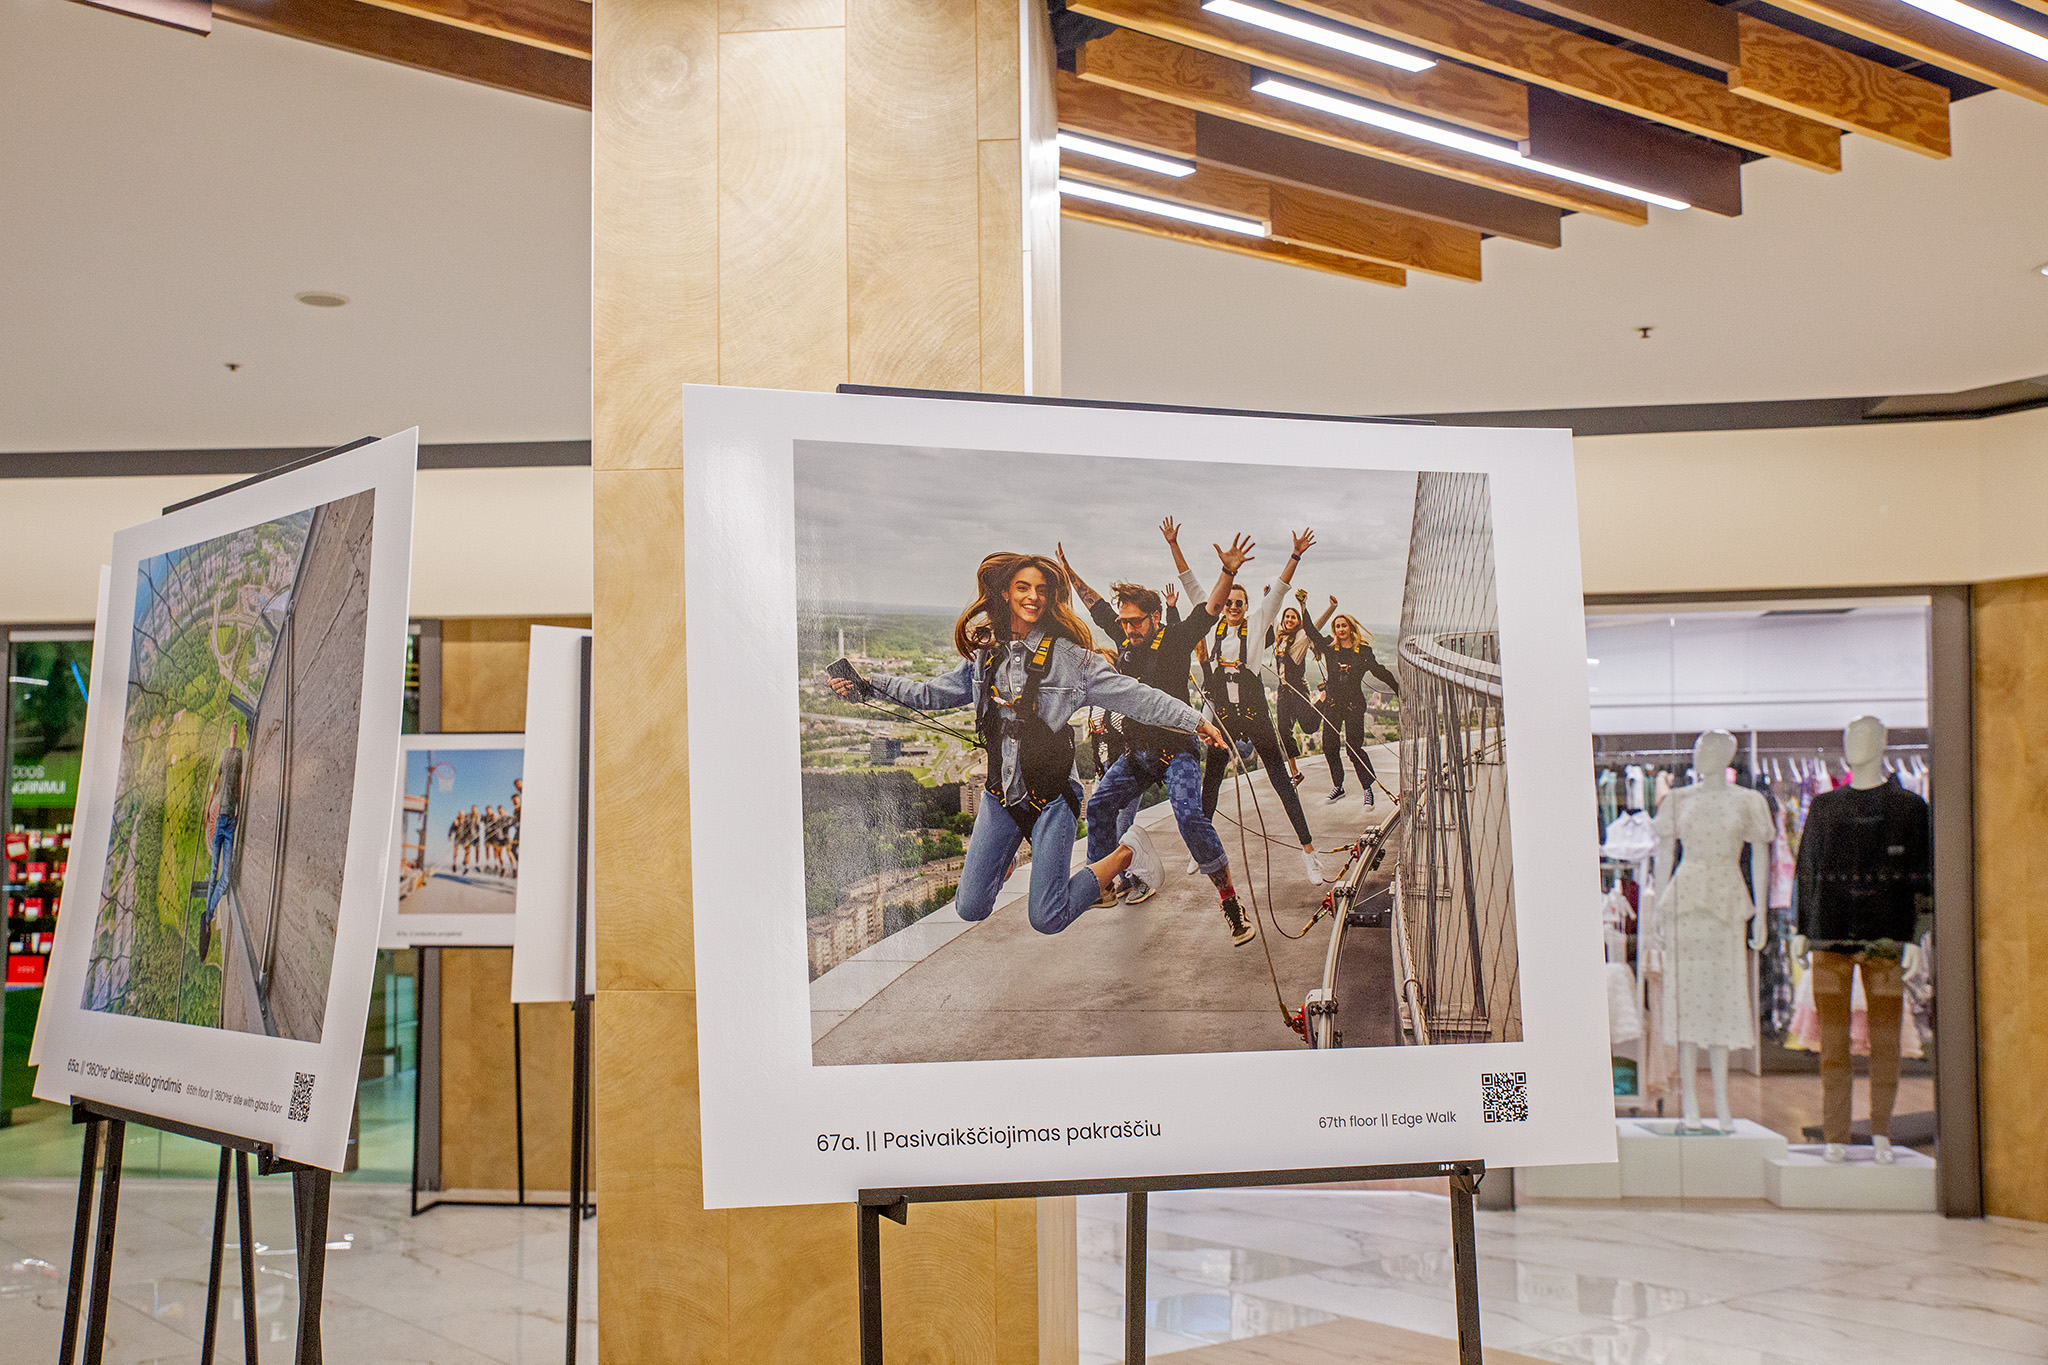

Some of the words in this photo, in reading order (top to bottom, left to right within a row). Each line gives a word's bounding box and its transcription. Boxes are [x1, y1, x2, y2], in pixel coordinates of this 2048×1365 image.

[67, 1058, 80, 1073] 65a.
[134, 1071, 152, 1088] stiklo
[150, 1075, 183, 1094] grindimis
[186, 1084, 198, 1096] 65th
[198, 1086, 210, 1099] floor
[233, 1094, 244, 1106] site
[243, 1096, 255, 1108] with
[254, 1098, 270, 1112] glass
[269, 1100, 283, 1114] floor
[1318, 1116, 1347, 1128] 67th
[1349, 1114, 1378, 1127] floor
[1391, 1113, 1423, 1128] Edge
[1425, 1111, 1457, 1124] Walk
[816, 1133, 860, 1153] 67a.
[883, 1125, 1061, 1149] Pasivaikščiojimas
[1066, 1119, 1162, 1146] pakraščiu
